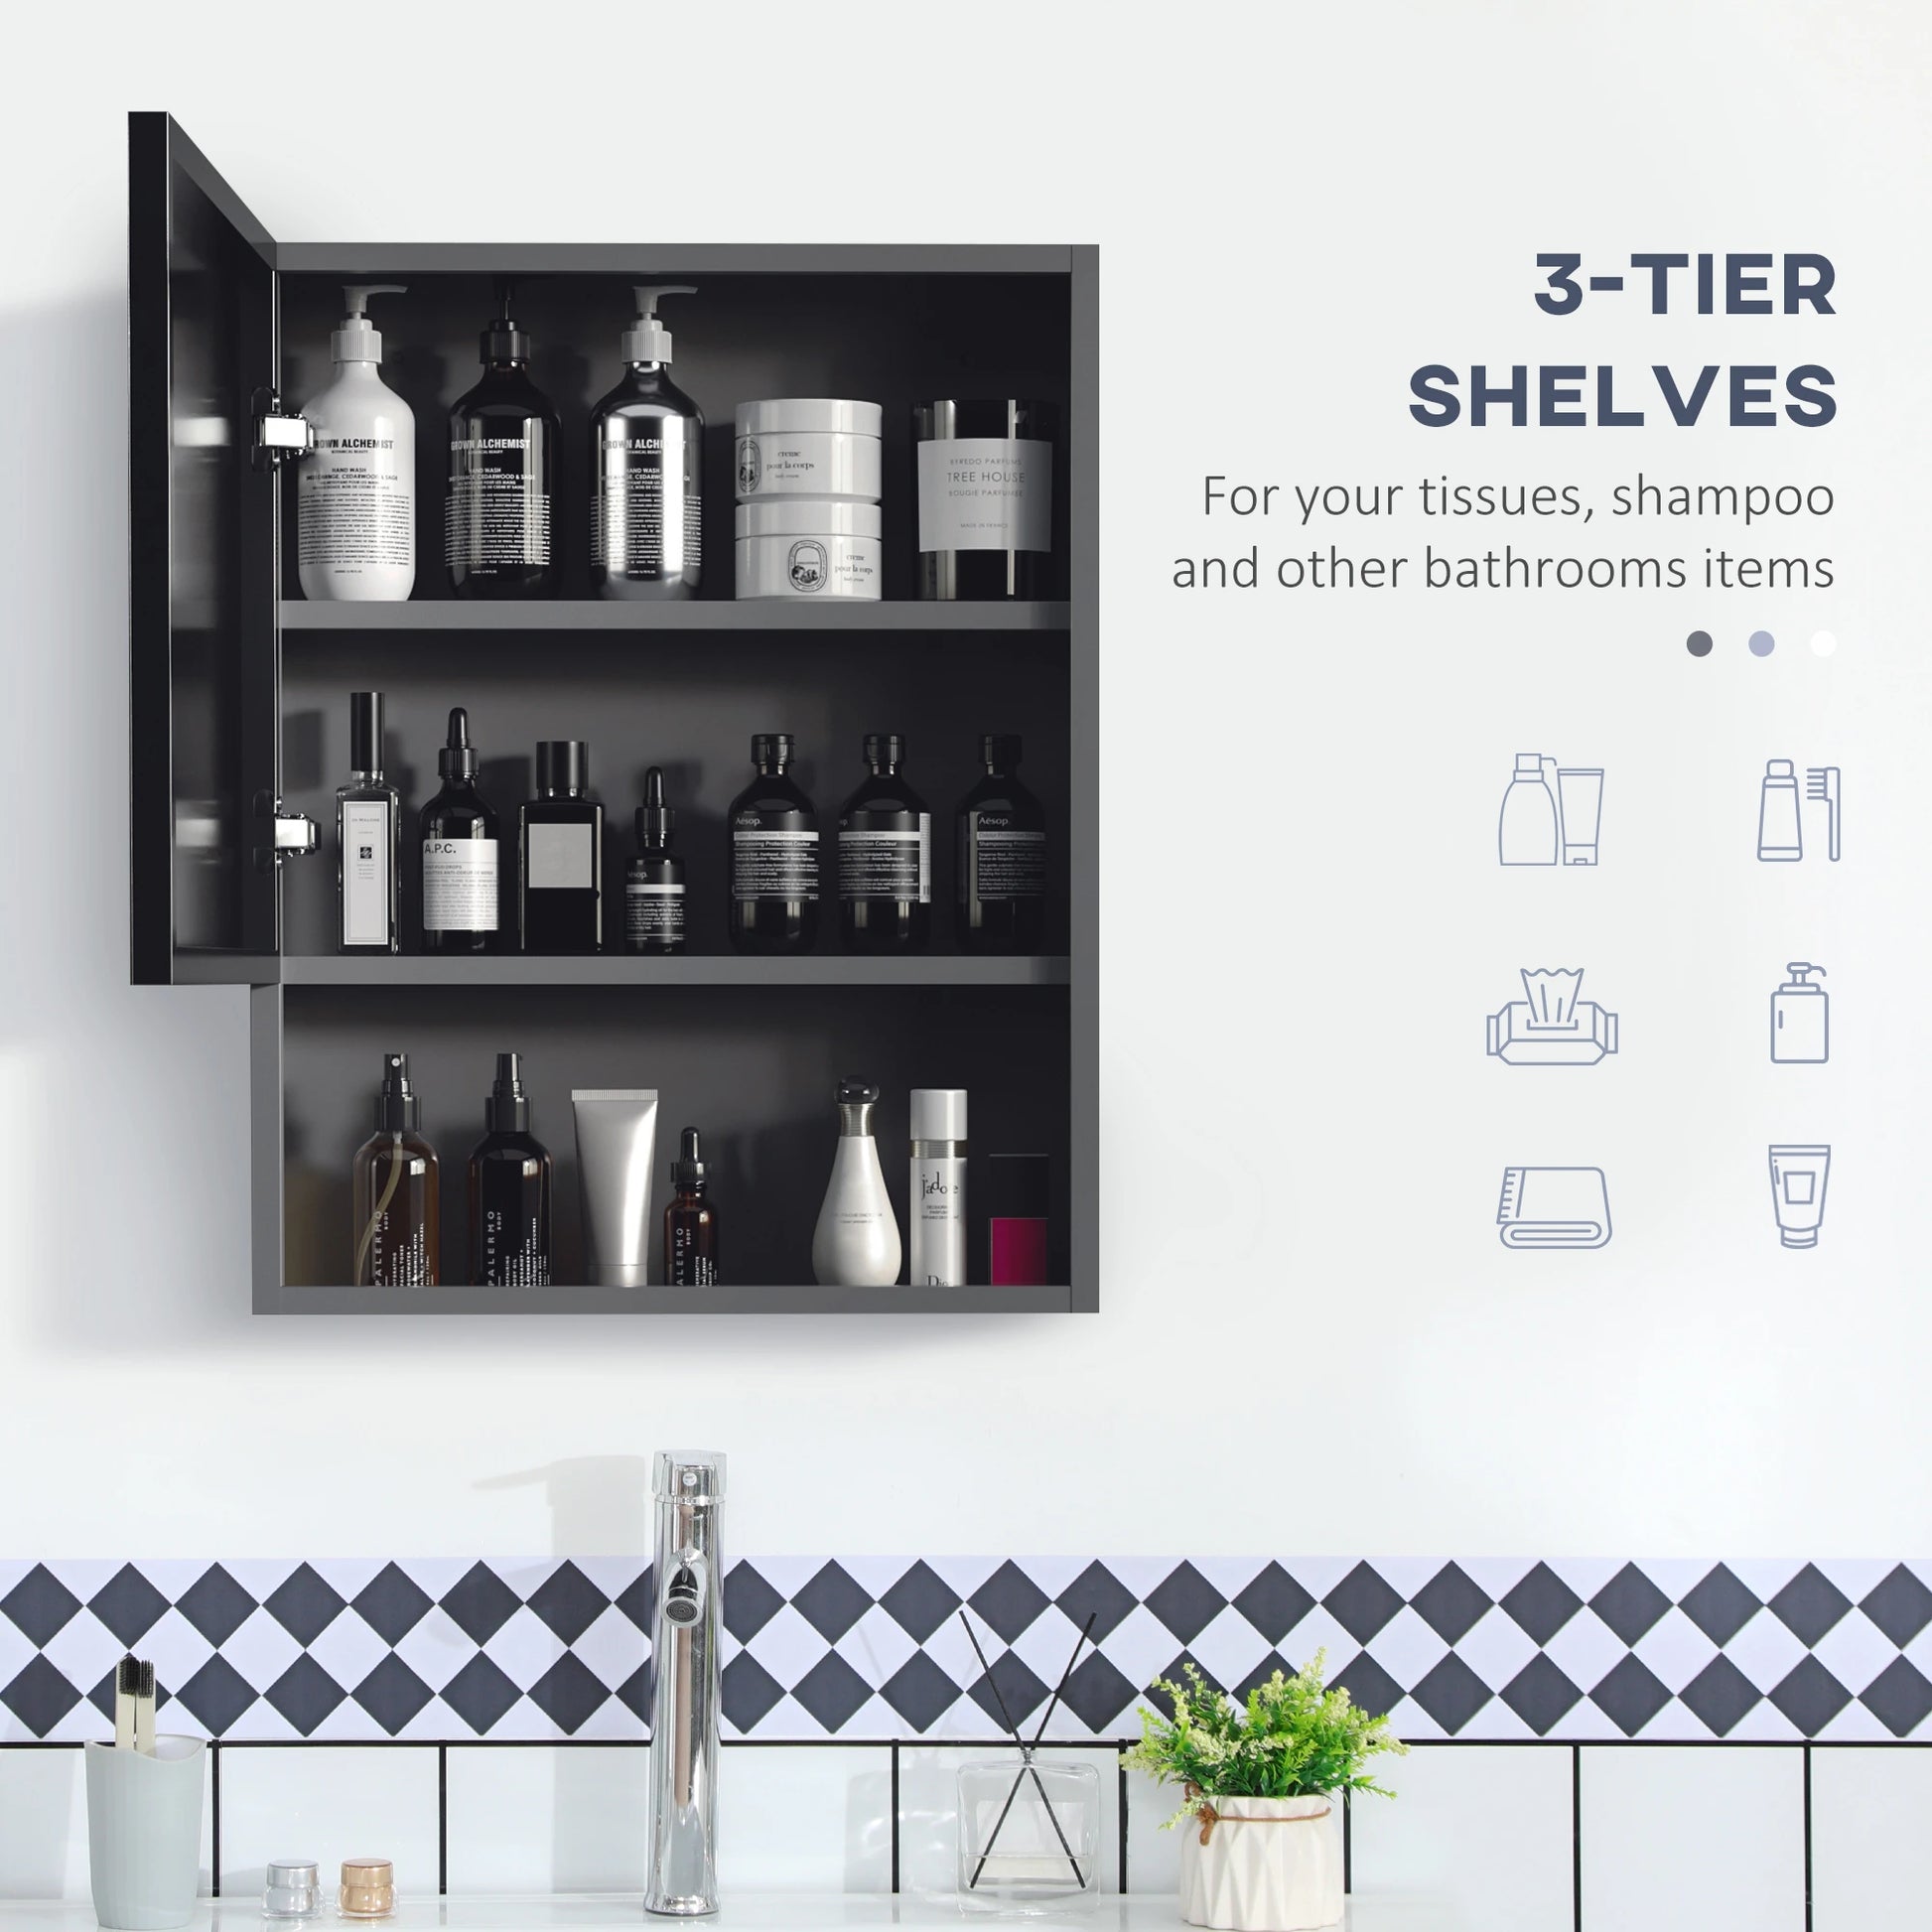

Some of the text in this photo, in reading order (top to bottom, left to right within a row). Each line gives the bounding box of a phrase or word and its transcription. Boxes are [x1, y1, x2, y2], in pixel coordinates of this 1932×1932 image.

[314, 439, 339, 449] ROWN
[477, 439, 531, 450] ALCHEMIST
[947, 472, 1026, 483] TREE HOUSE
[424, 843, 457, 854] A.P.C.
[921, 1171, 959, 1201] j'adoe
[927, 1275, 948, 1288] Dio
